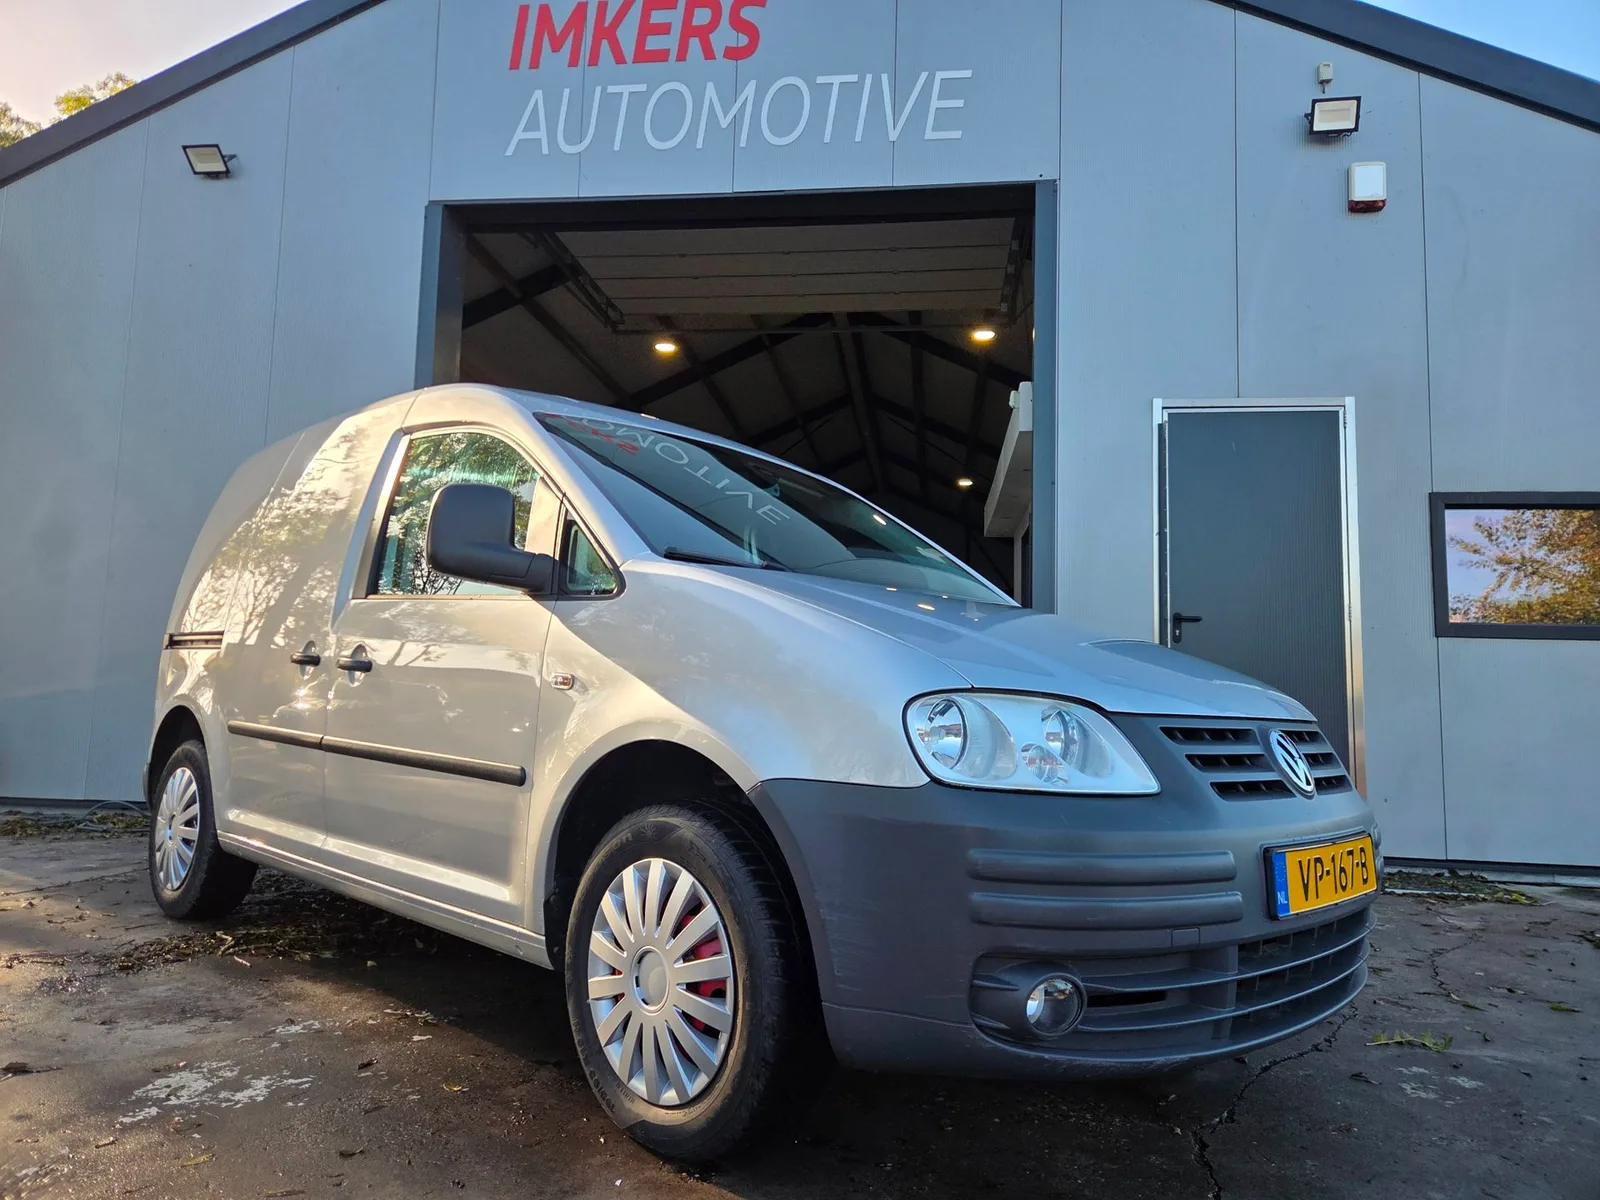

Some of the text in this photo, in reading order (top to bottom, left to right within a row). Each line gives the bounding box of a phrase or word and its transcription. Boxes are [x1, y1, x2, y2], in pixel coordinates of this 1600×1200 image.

[508, 0, 767, 70] IMKERS
[504, 70, 973, 156] AUTOMOTIVE
[1277, 890, 1288, 905] NL
[1298, 846, 1369, 902] VP-167-B
